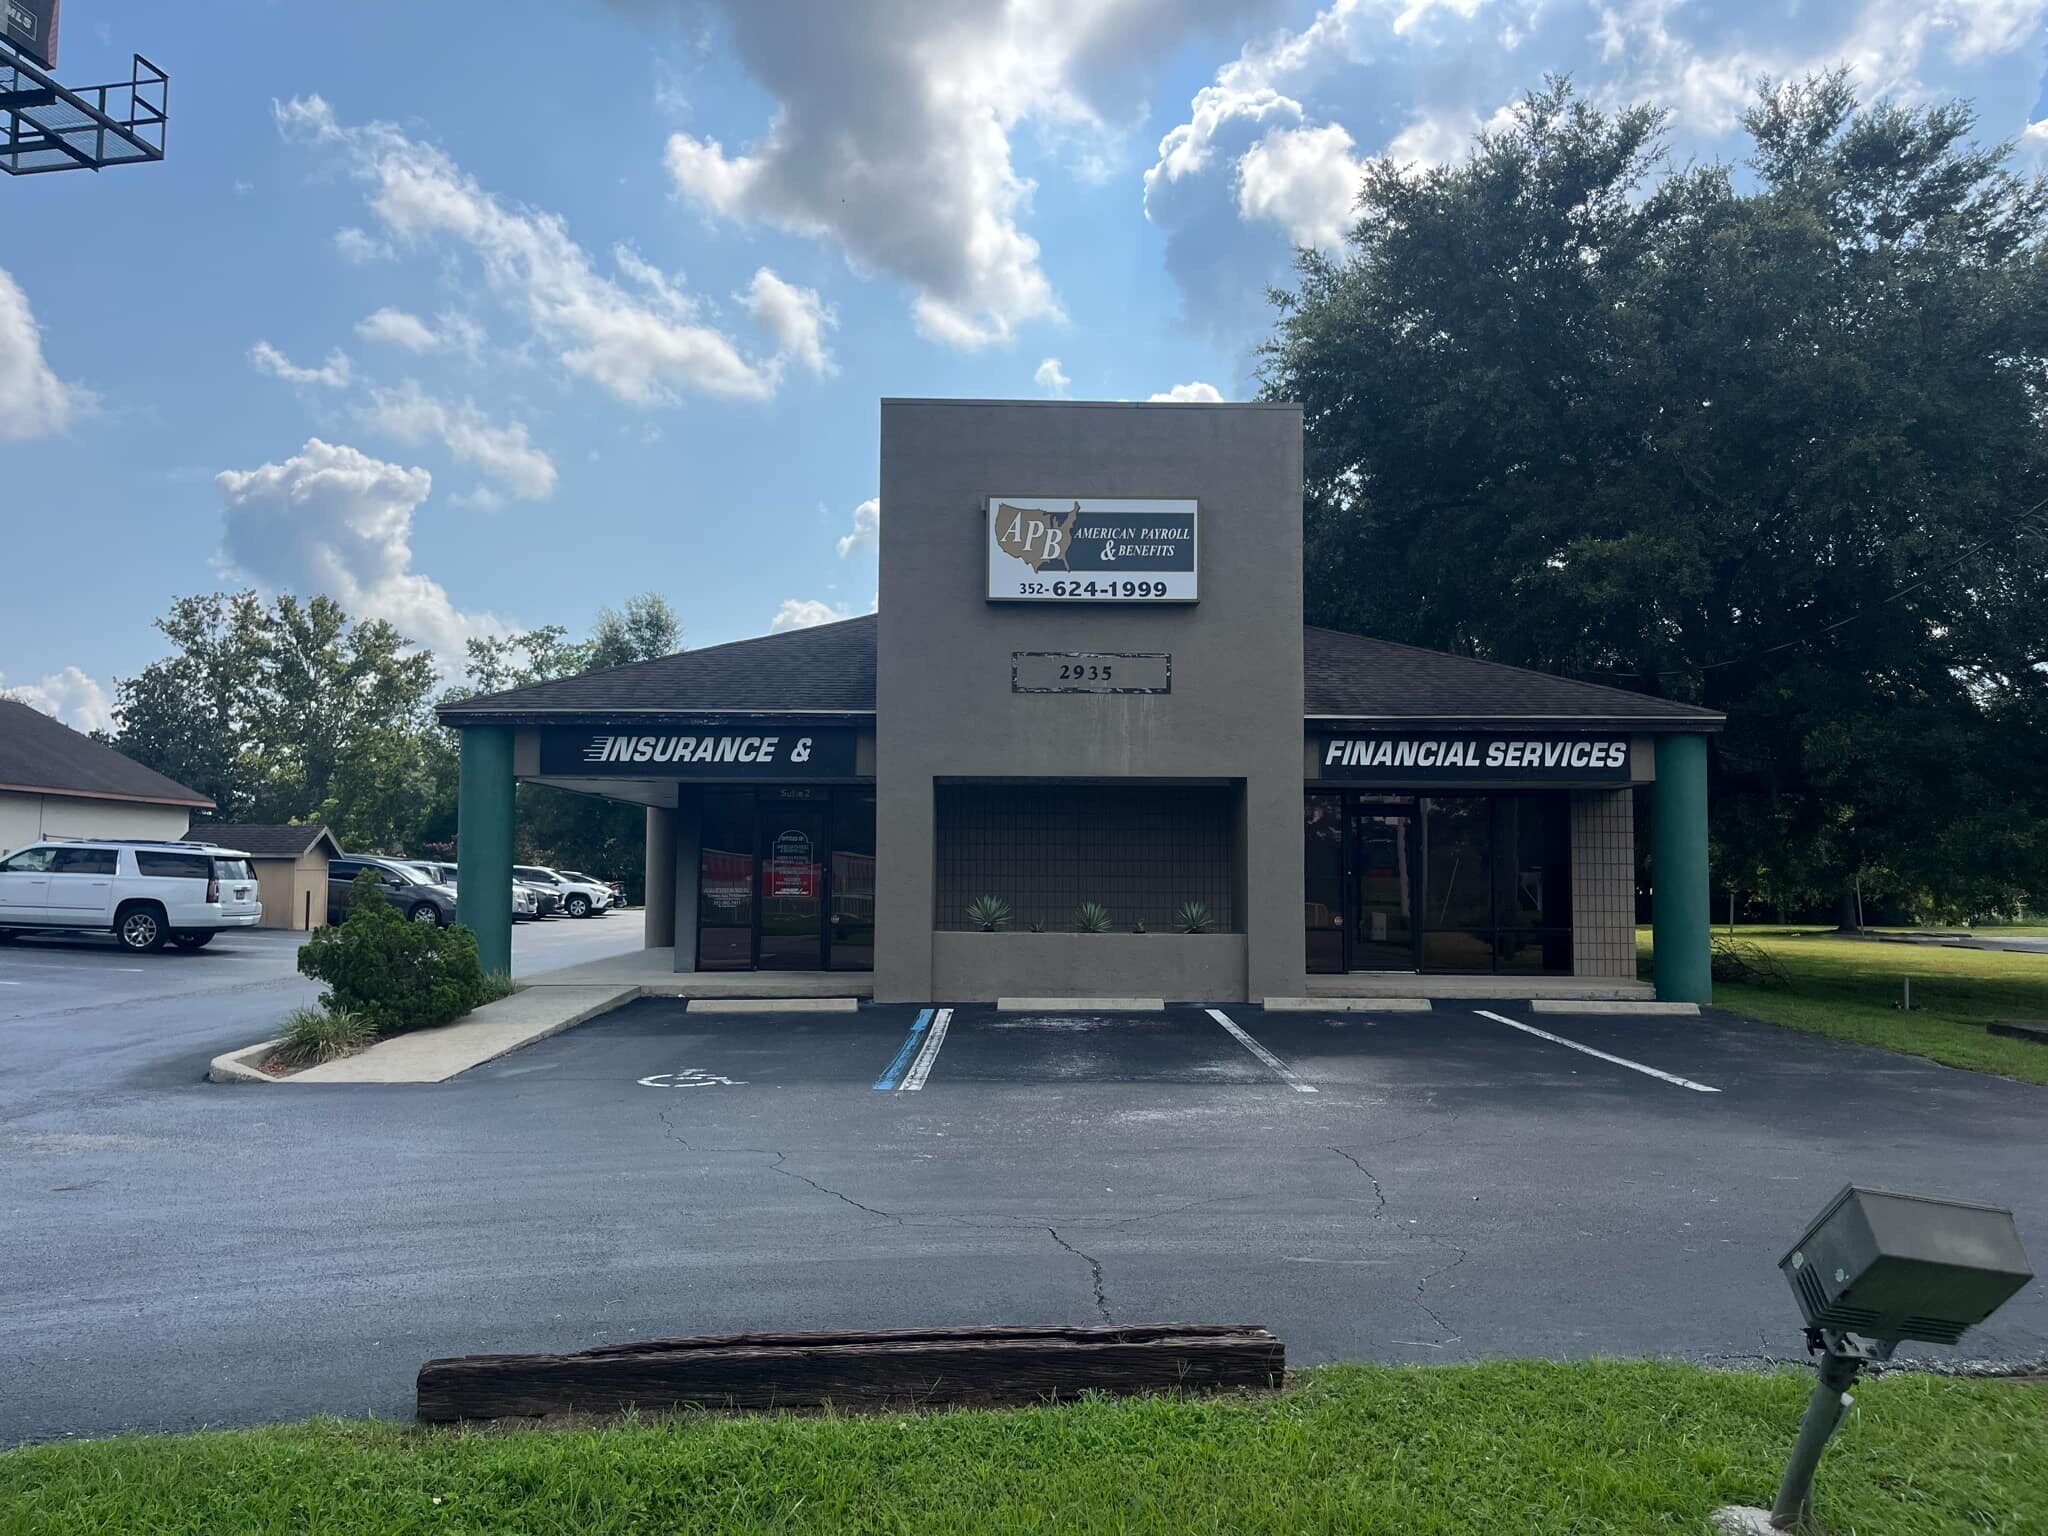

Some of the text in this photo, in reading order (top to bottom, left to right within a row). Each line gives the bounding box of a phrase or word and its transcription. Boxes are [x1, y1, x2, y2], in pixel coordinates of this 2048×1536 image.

[1000, 511, 1063, 560] APB
[1074, 527, 1190, 540] AMERICAN PAYROLL
[1100, 540, 1175, 561] & BENEFITS
[1019, 581, 1167, 597] 352-624-1999
[1059, 664, 1112, 681] 2935
[598, 736, 812, 762] INSURANCE &
[1325, 740, 1627, 768] FINANCIAL SERVICES
[780, 789, 803, 798] Sue
